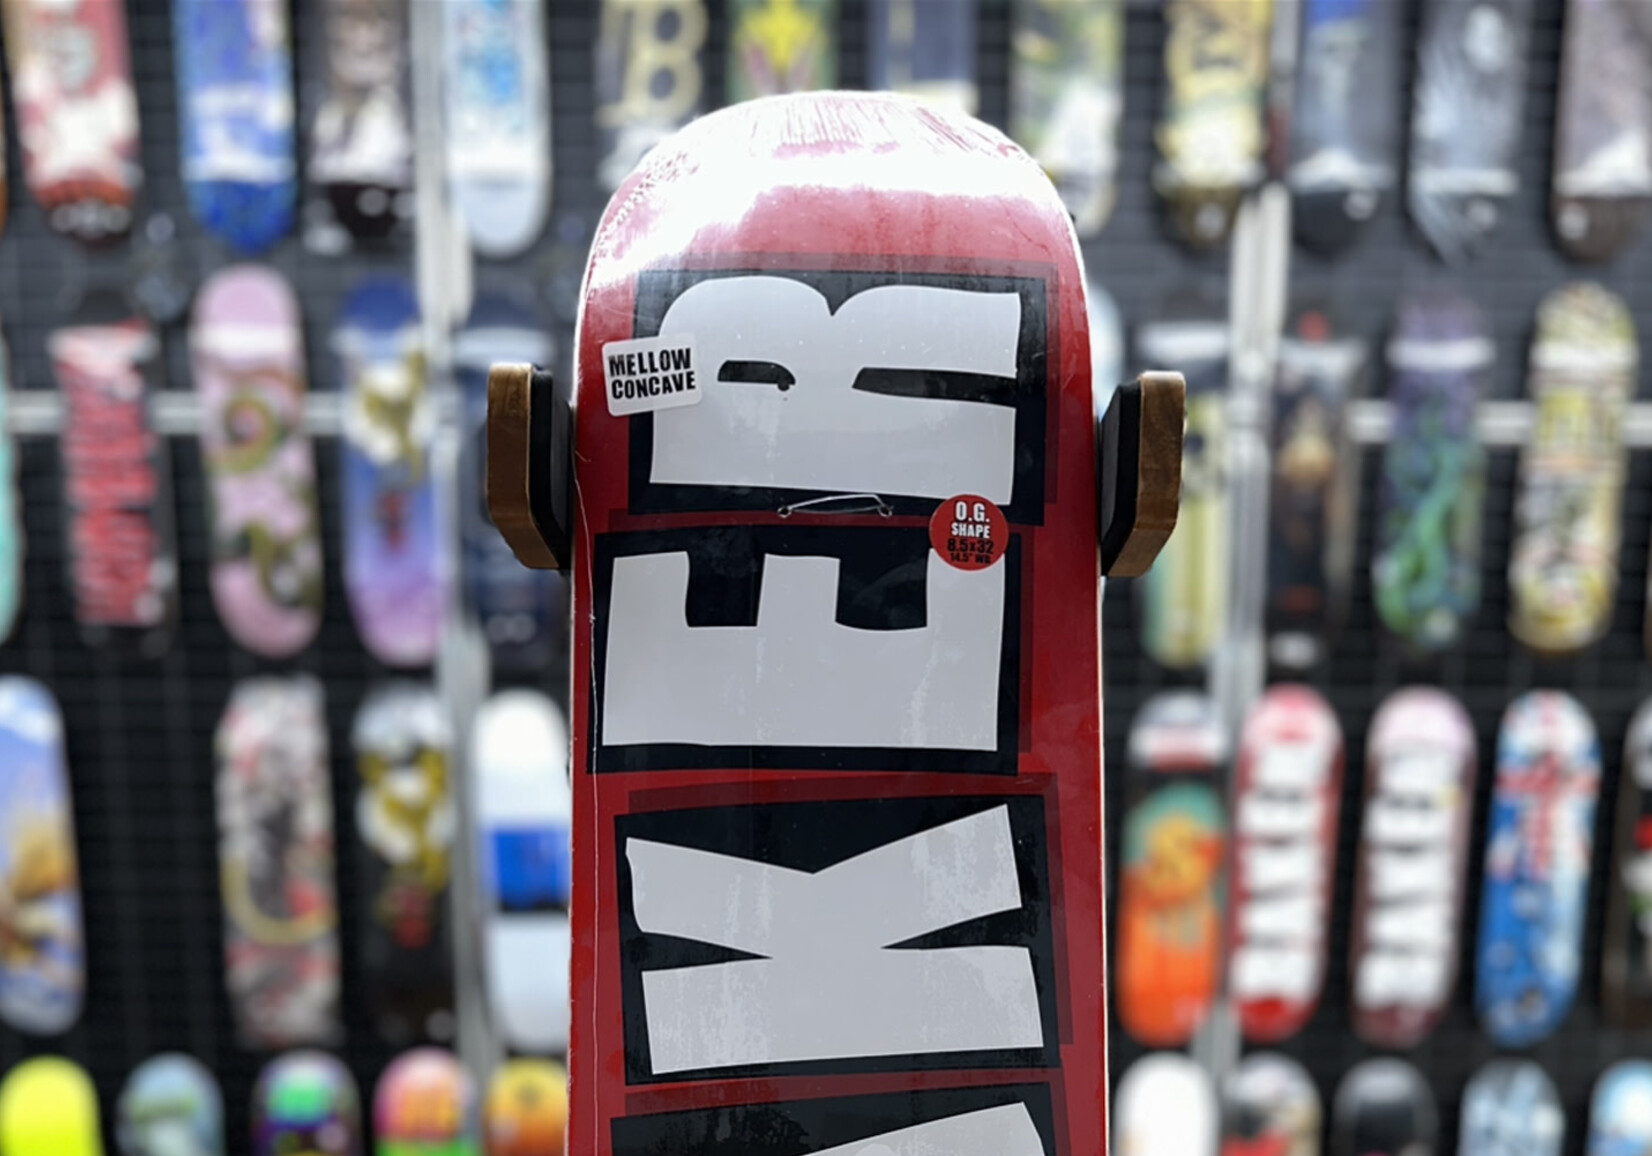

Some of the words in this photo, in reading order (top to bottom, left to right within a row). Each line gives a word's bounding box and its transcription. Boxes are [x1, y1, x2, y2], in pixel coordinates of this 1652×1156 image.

[608, 347, 692, 378] MELLOW
[611, 371, 697, 400] CONCAVE
[955, 501, 990, 523] O.G.
[951, 522, 991, 539] SHAPE
